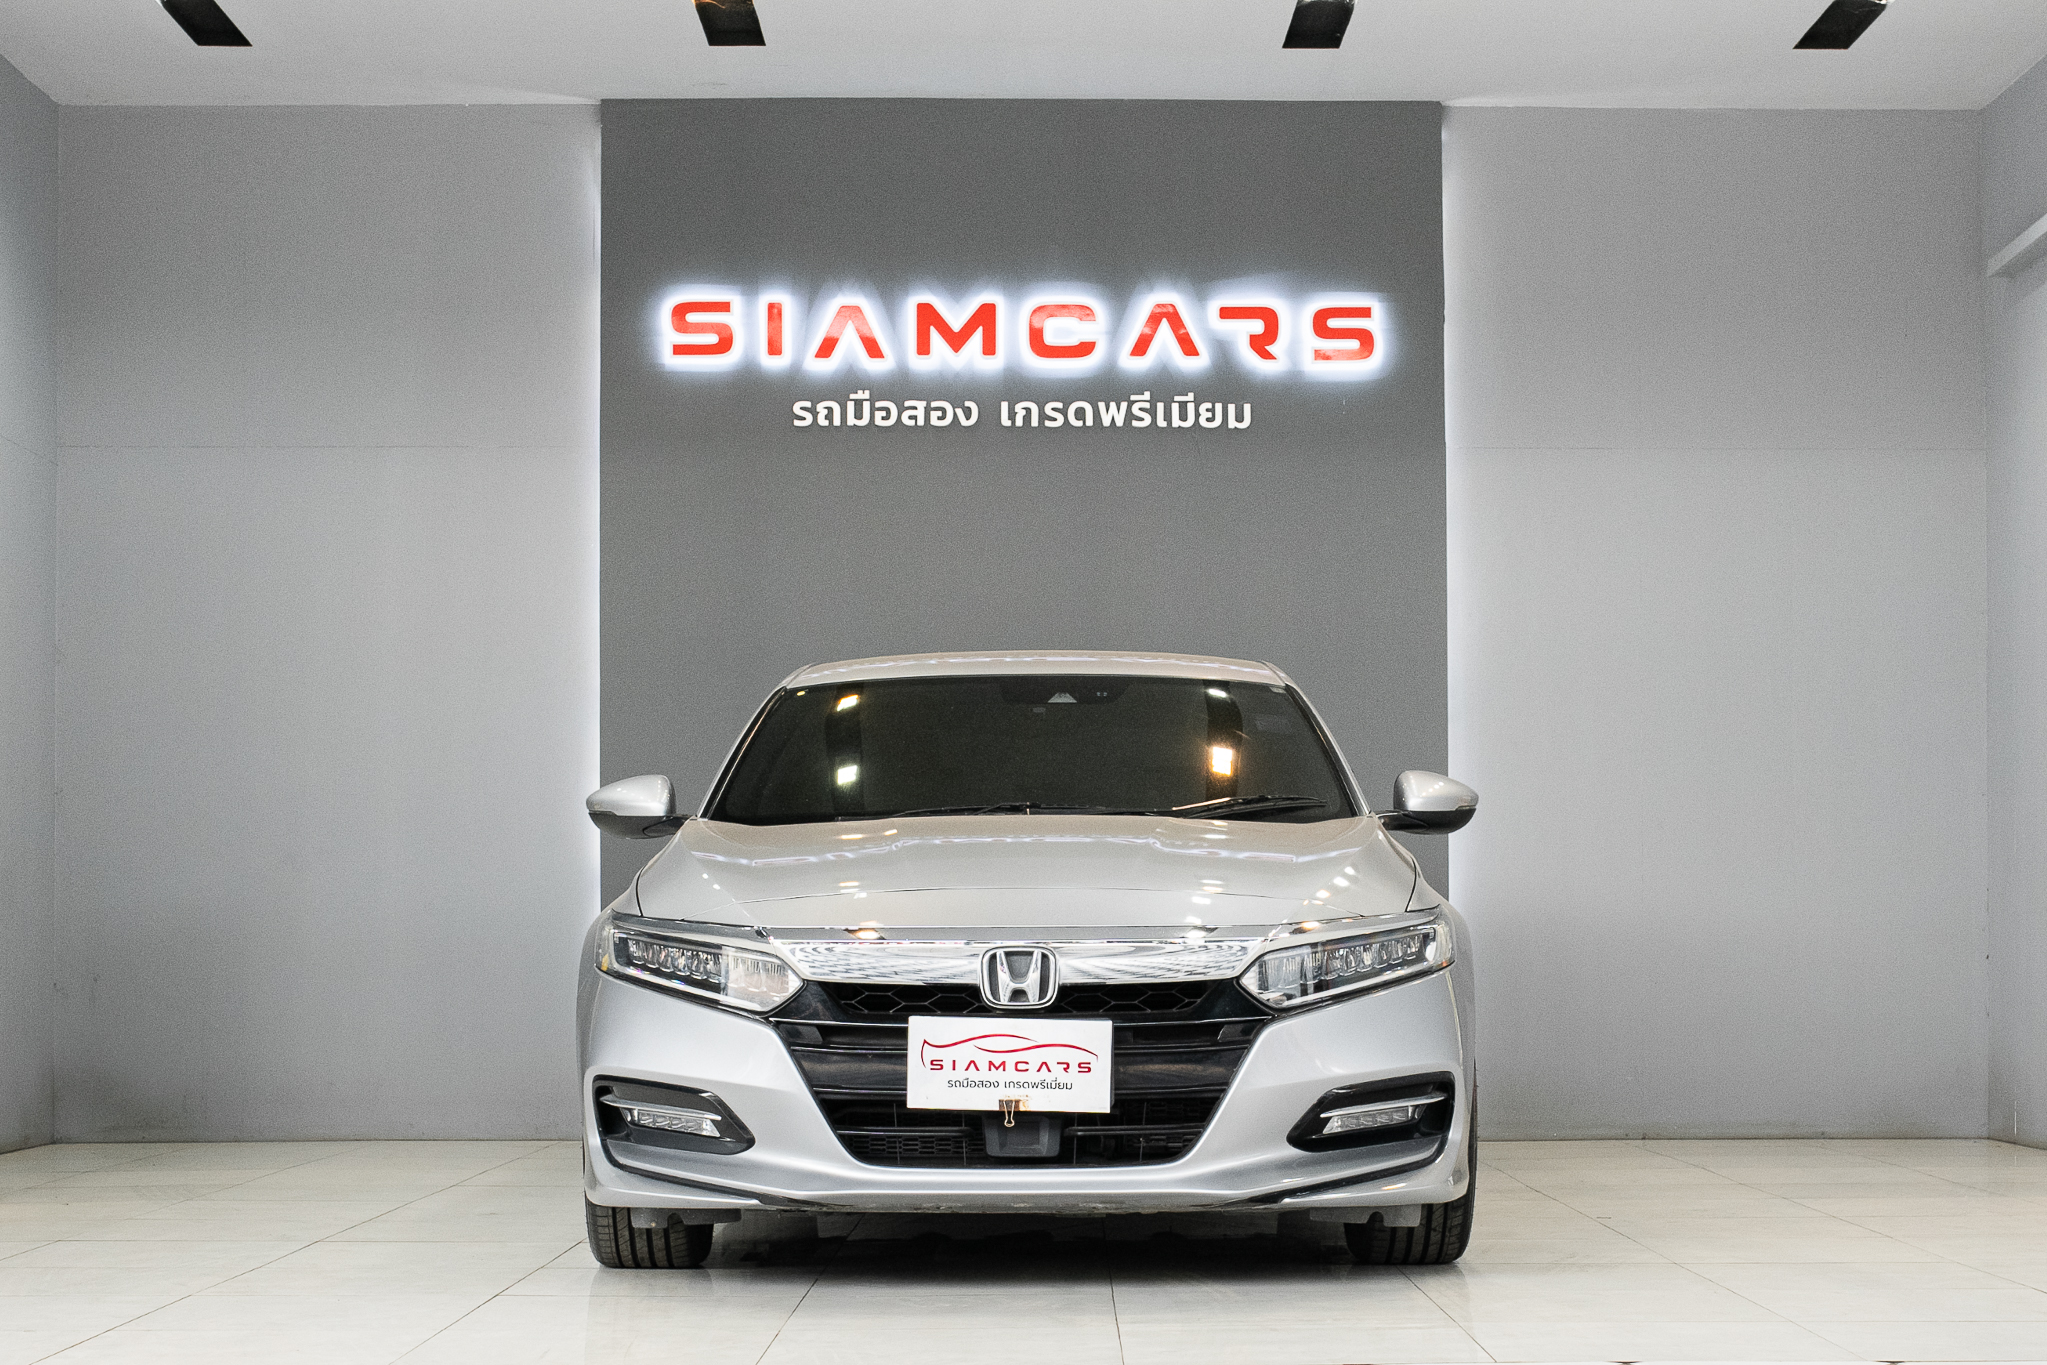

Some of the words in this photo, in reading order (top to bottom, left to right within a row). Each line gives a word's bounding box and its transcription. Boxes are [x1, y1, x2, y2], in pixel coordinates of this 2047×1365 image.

[669, 300, 1376, 362] SIAMCARS
[792, 389, 979, 427] รถมือสอง
[1000, 390, 1252, 429] เกรดพรีเมียม
[929, 1058, 1092, 1074] SIAMCARS
[947, 1077, 1000, 1089] รถมือสอง
